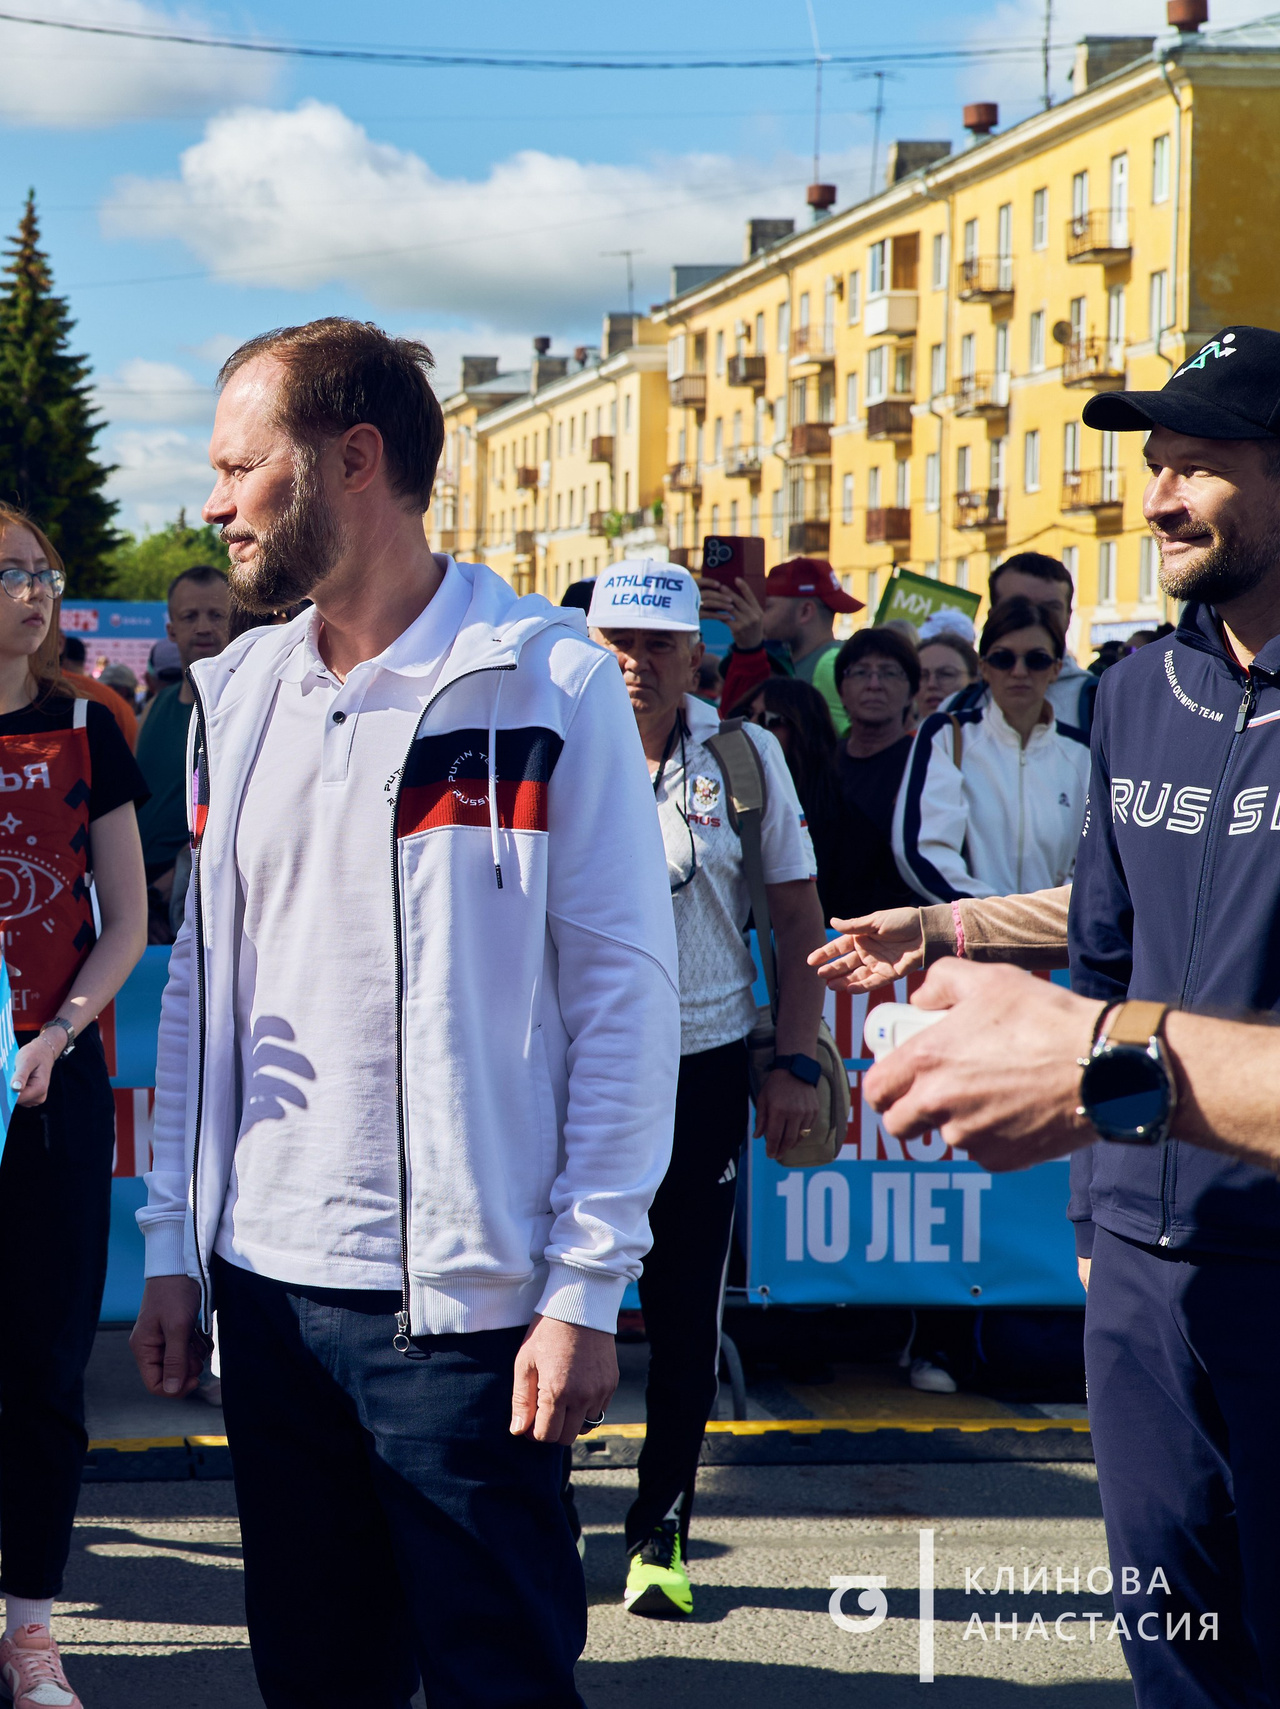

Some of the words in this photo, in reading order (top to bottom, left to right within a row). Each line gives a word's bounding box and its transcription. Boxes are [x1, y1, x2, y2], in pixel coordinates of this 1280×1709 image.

[604, 575, 683, 592] ATHLETICS
[611, 593, 671, 609] LEAGUE
[1163, 650, 1178, 688] RUSSIAN
[1173, 685, 1199, 713] OLYMPIC
[1197, 706, 1224, 723] TEAM
[448, 750, 473, 782] PUTIN
[452, 789, 492, 806] RUSSI
[686, 814, 721, 827] RUS
[776, 1171, 851, 1263] 10
[866, 1172, 992, 1263] ЛЕТ
